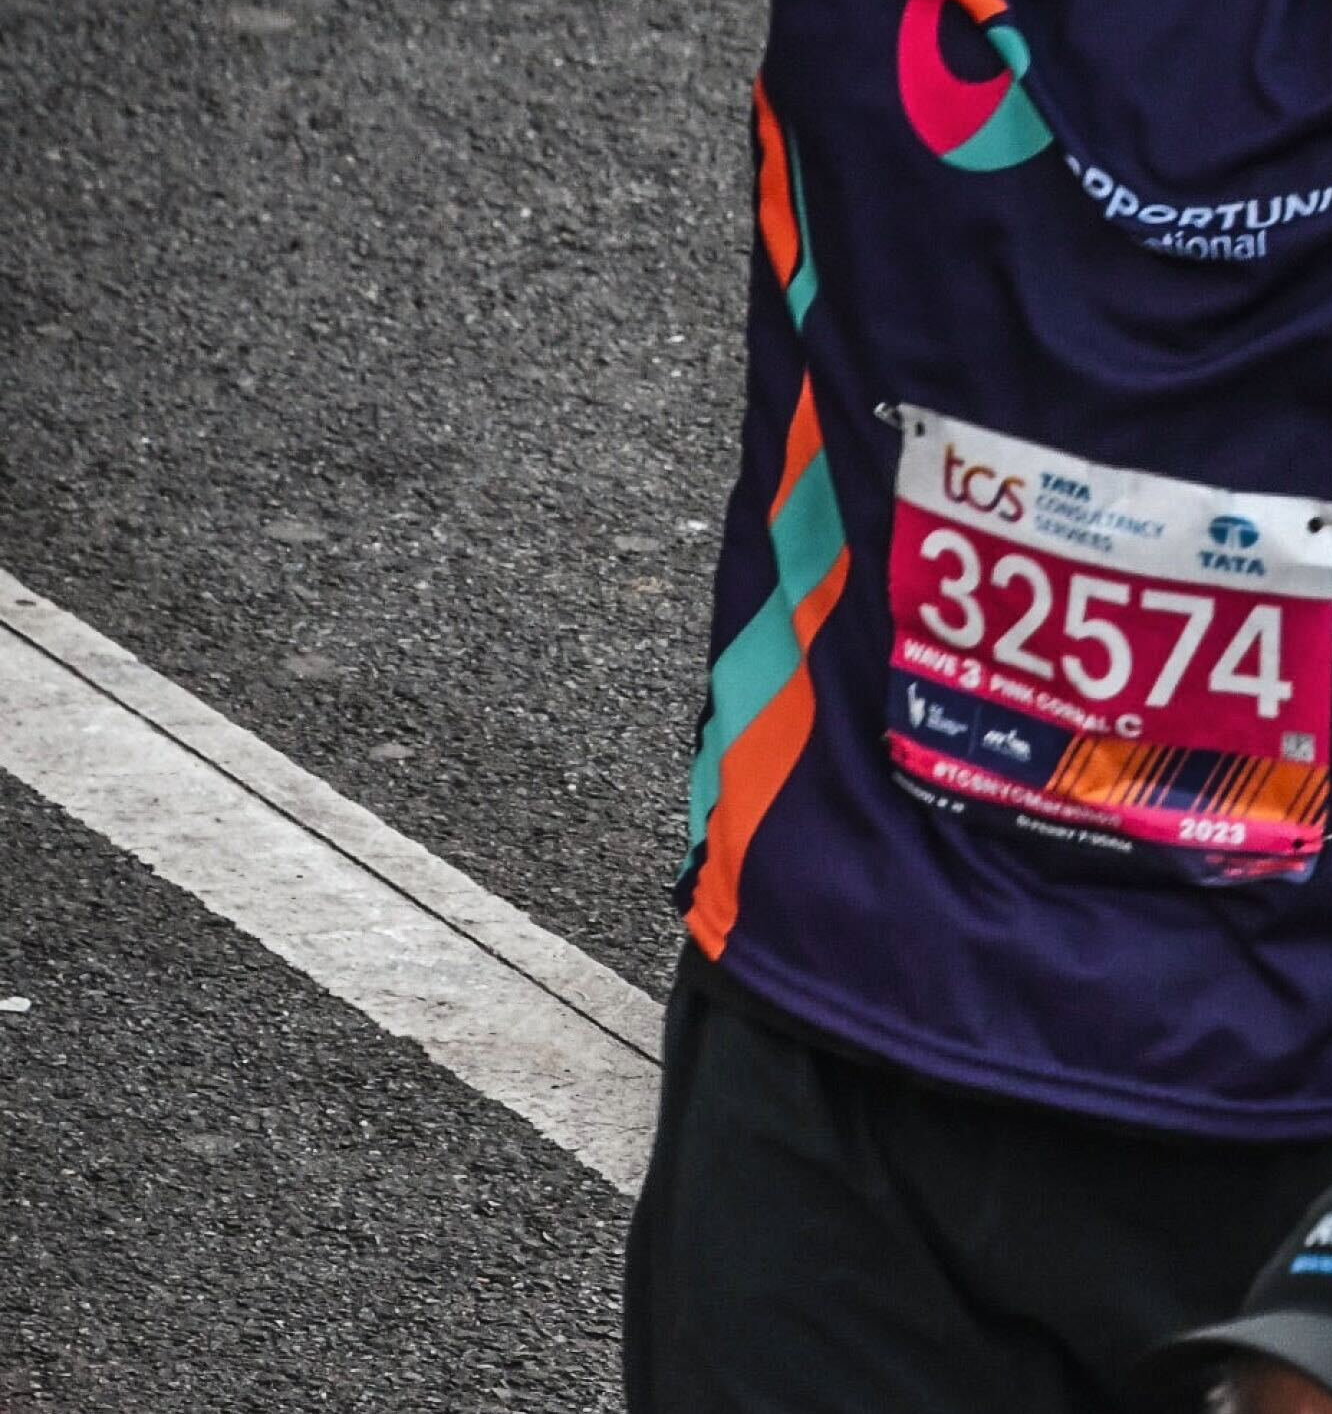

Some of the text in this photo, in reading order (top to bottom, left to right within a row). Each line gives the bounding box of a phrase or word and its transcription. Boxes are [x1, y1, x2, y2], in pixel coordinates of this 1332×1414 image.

[941, 442, 1025, 522] tcs
[1199, 550, 1265, 578] TATA
[919, 527, 1294, 719] 32574
[1115, 713, 1143, 738] C
[1179, 817, 1246, 846] 2023
